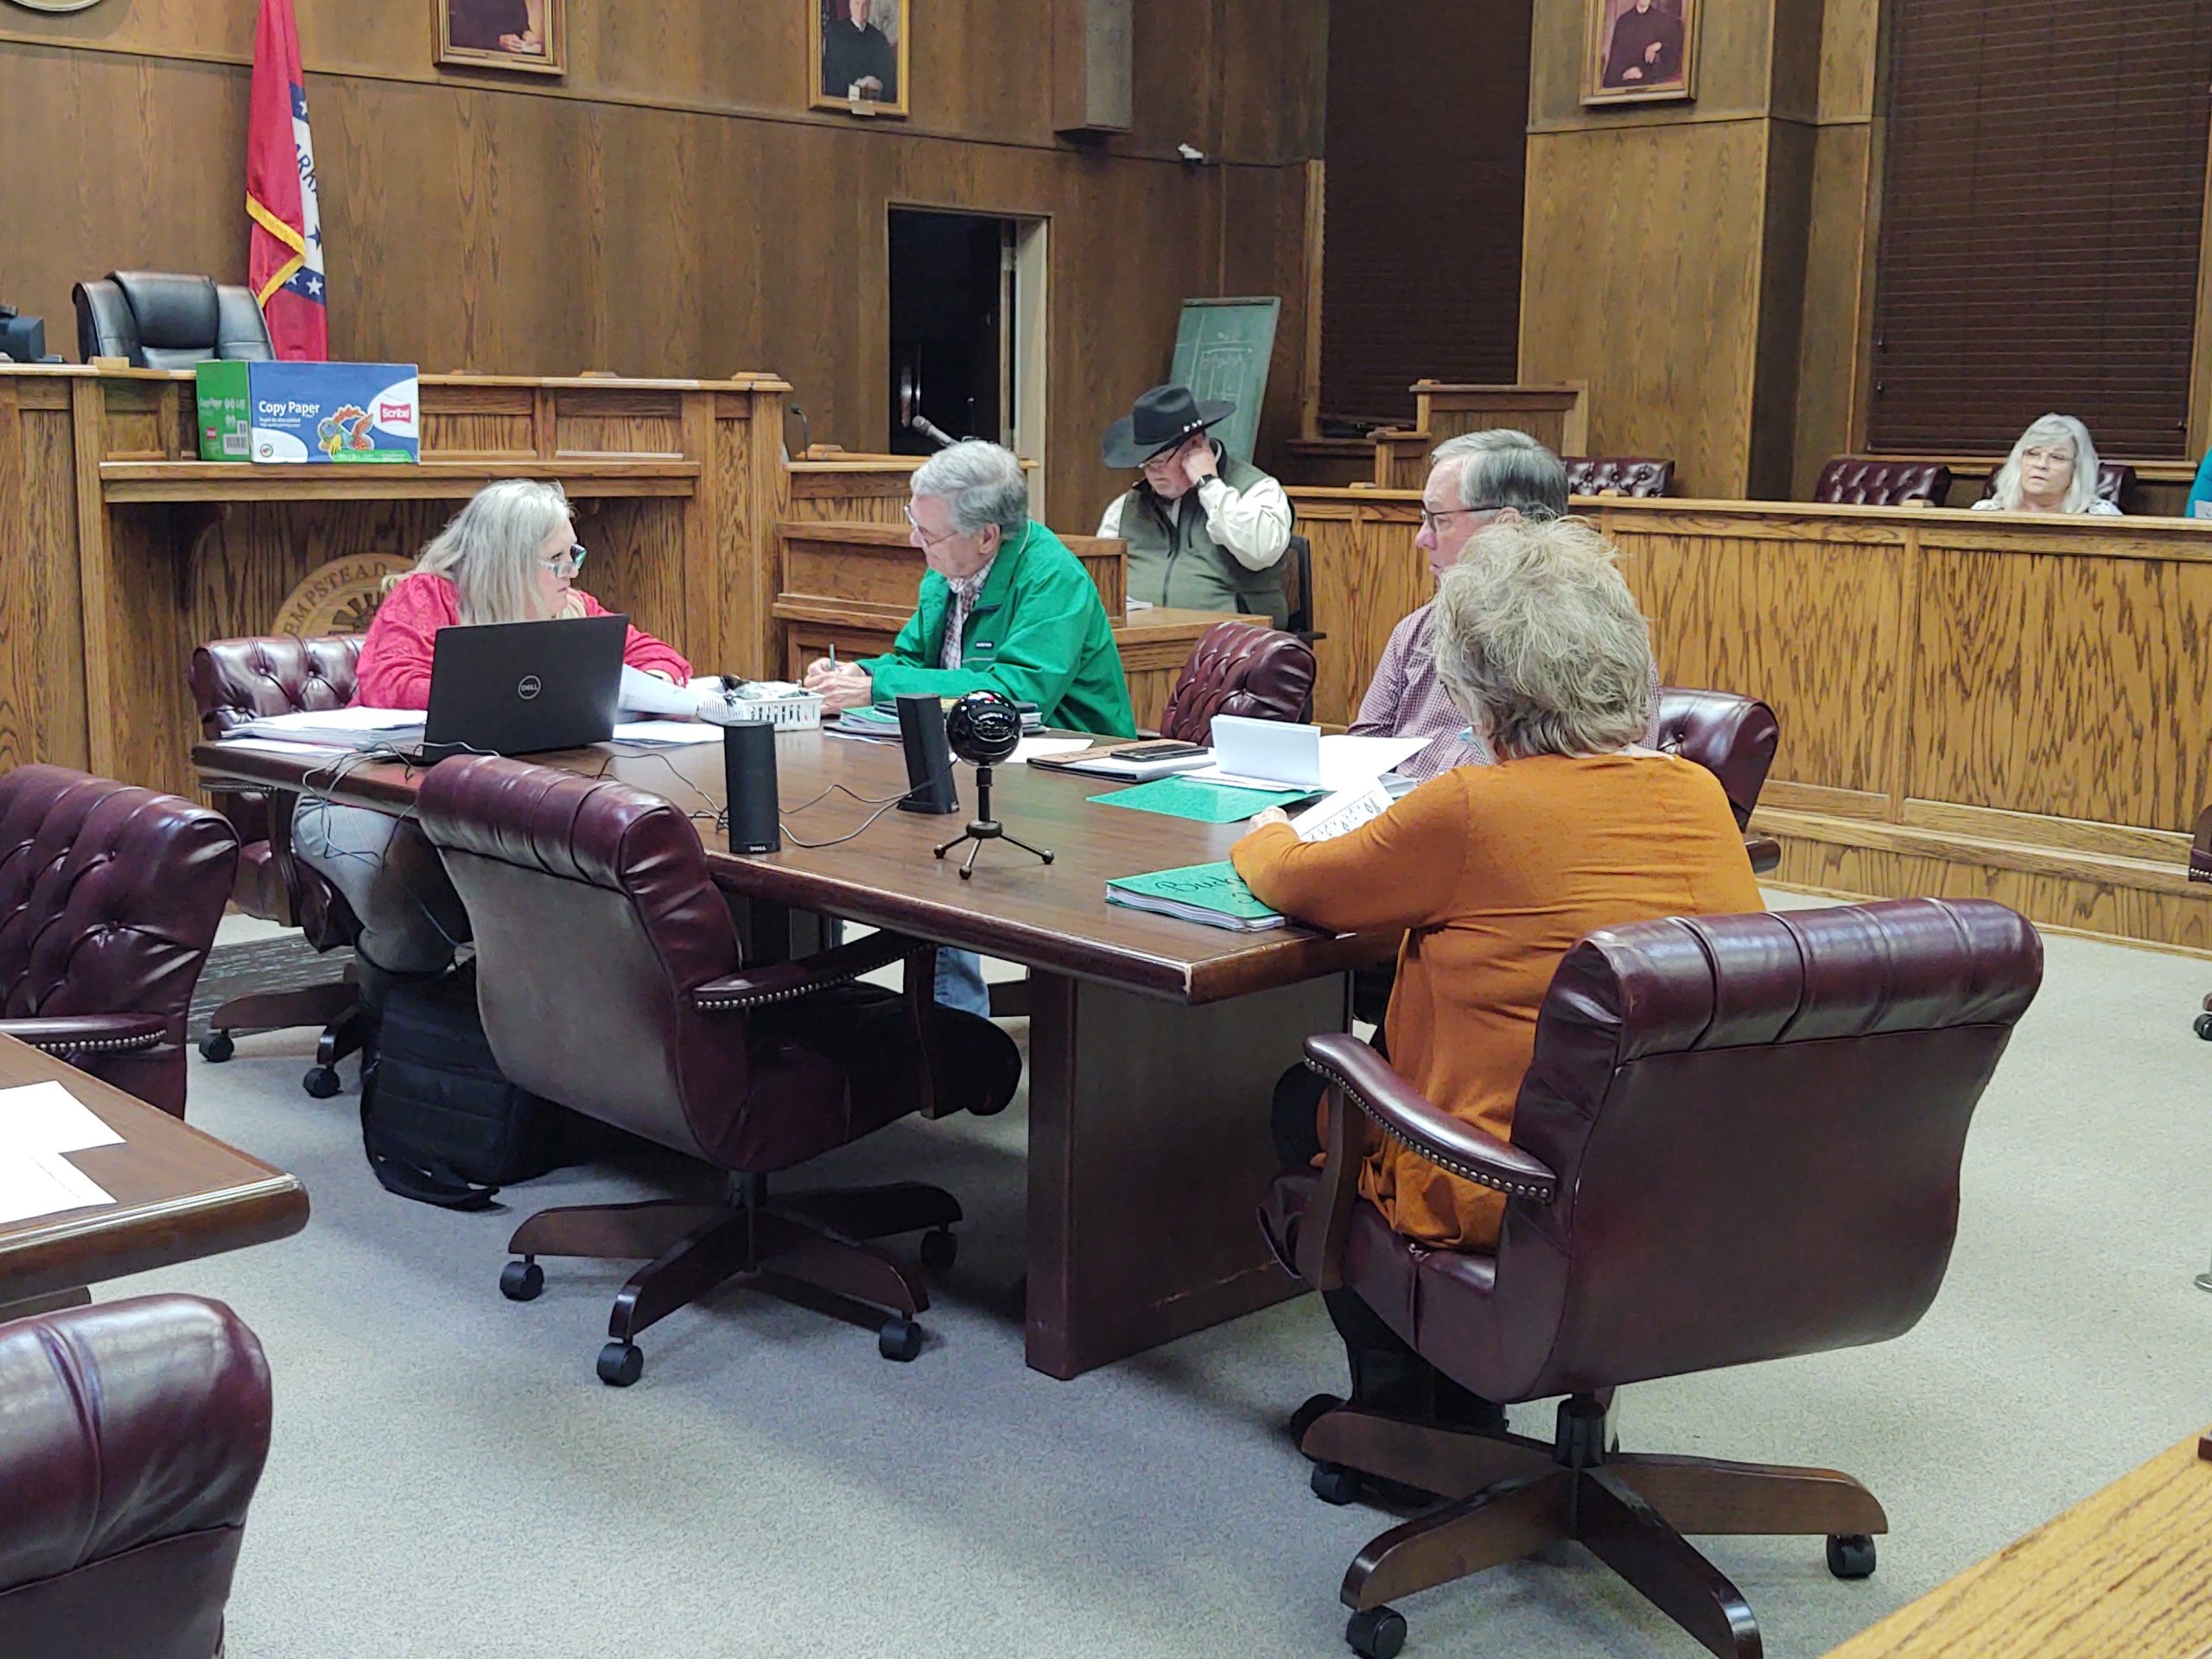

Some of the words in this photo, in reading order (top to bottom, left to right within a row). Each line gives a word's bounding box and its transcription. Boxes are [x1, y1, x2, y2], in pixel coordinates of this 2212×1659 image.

[258, 400, 286, 416] Copy
[289, 401, 320, 417] Paper
[381, 408, 410, 419] Scribe
